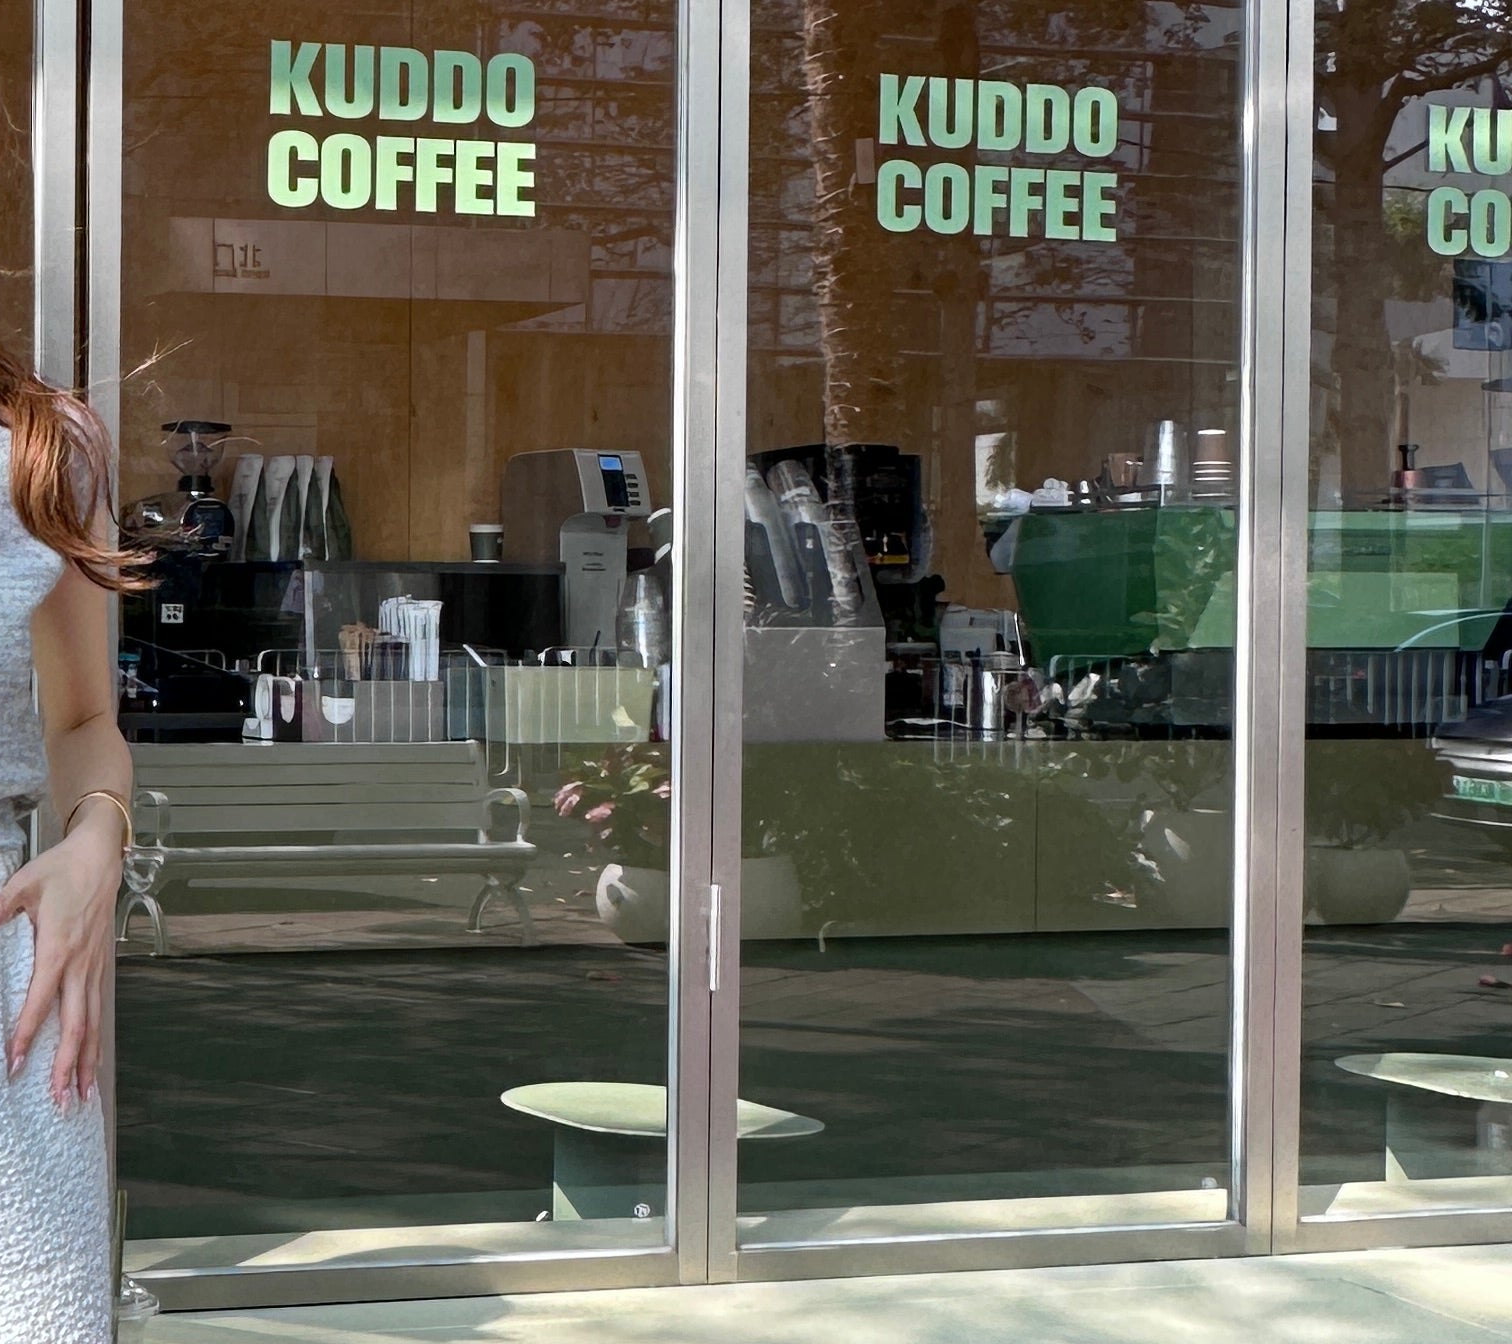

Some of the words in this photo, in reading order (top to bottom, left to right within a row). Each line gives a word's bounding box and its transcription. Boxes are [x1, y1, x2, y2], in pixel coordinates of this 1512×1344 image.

[270, 40, 536, 128] KUDDO
[879, 73, 1118, 159] KUDDO
[268, 130, 537, 218] COFFEE
[877, 159, 1118, 243] COFFEE
